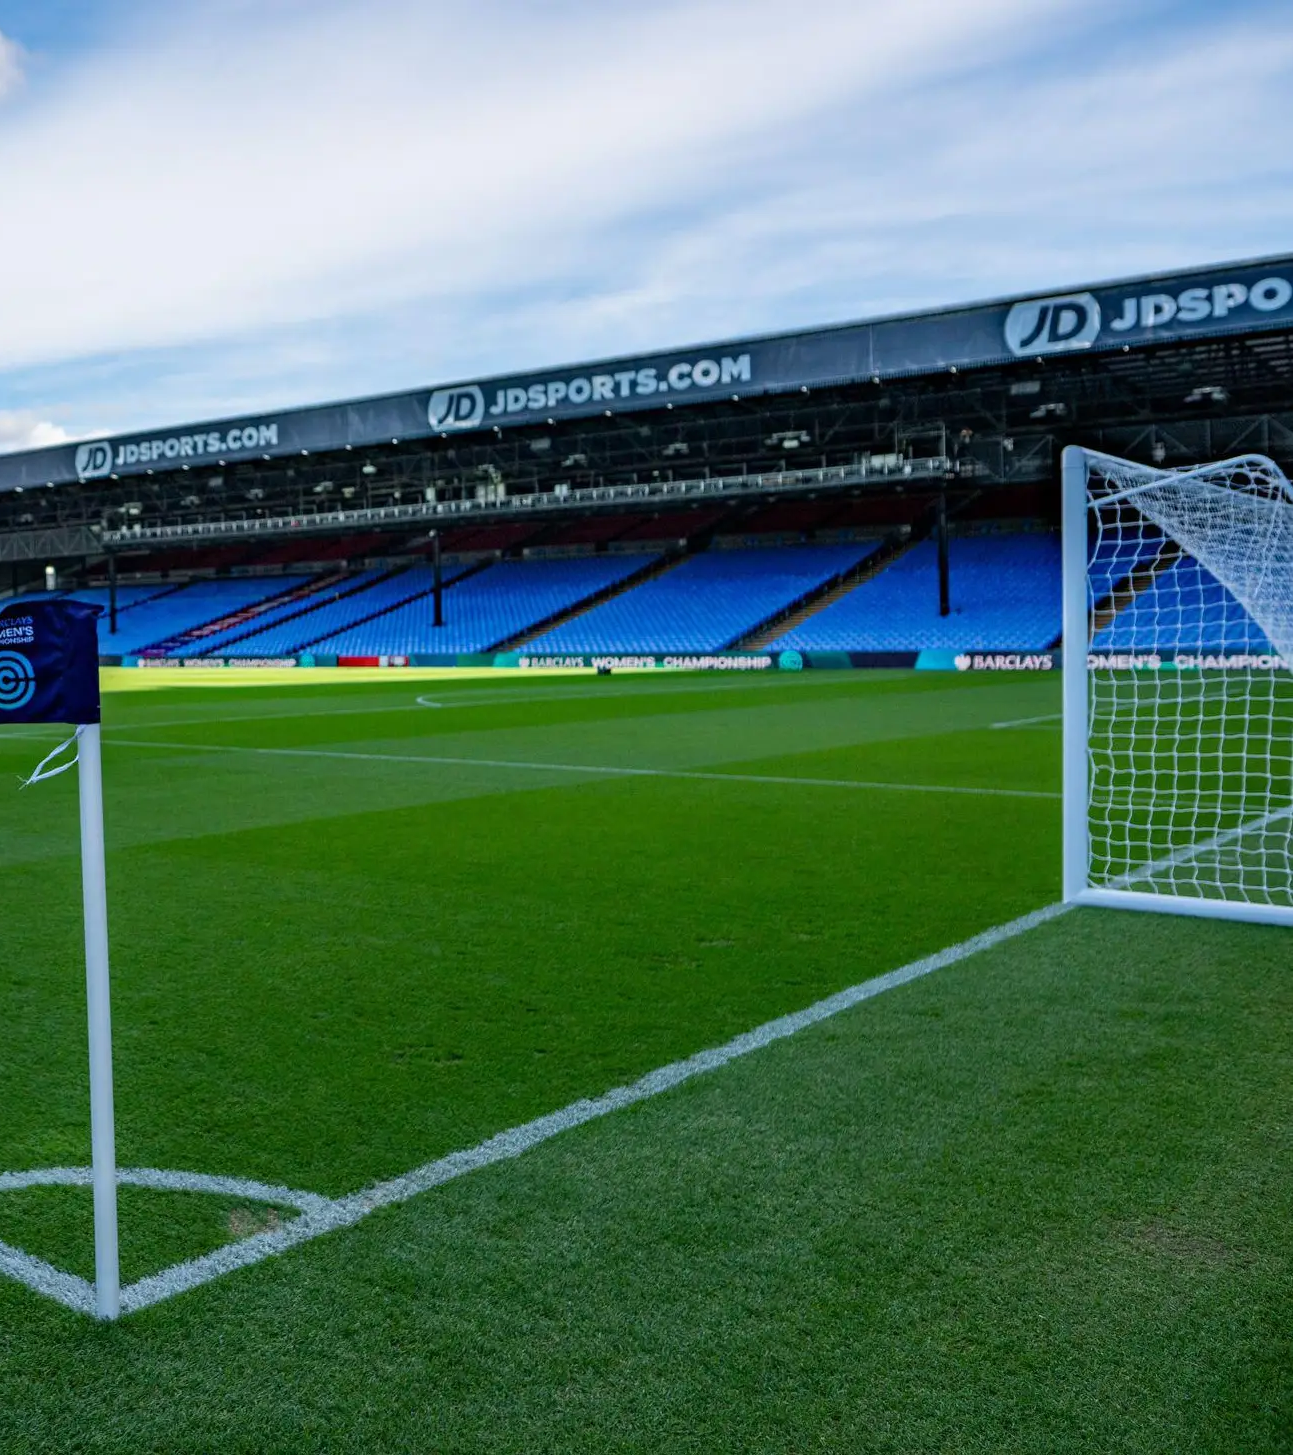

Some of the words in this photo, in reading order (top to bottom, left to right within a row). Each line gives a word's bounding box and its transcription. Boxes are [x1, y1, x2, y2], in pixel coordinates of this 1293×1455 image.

[1019, 303, 1088, 348] JD
[1110, 277, 1293, 332] JDSPO
[437, 390, 478, 425] JD
[489, 354, 752, 416] JDSPORTS.COM
[115, 424, 279, 467] JDSPORTS.COM
[531, 656, 584, 668] BARCLAYS
[591, 656, 656, 669] WOMEN'S
[663, 656, 772, 669] CHAMPIONSHIP
[973, 655, 1053, 670] BARCLAYS
[1087, 654, 1162, 670] OMEN'S
